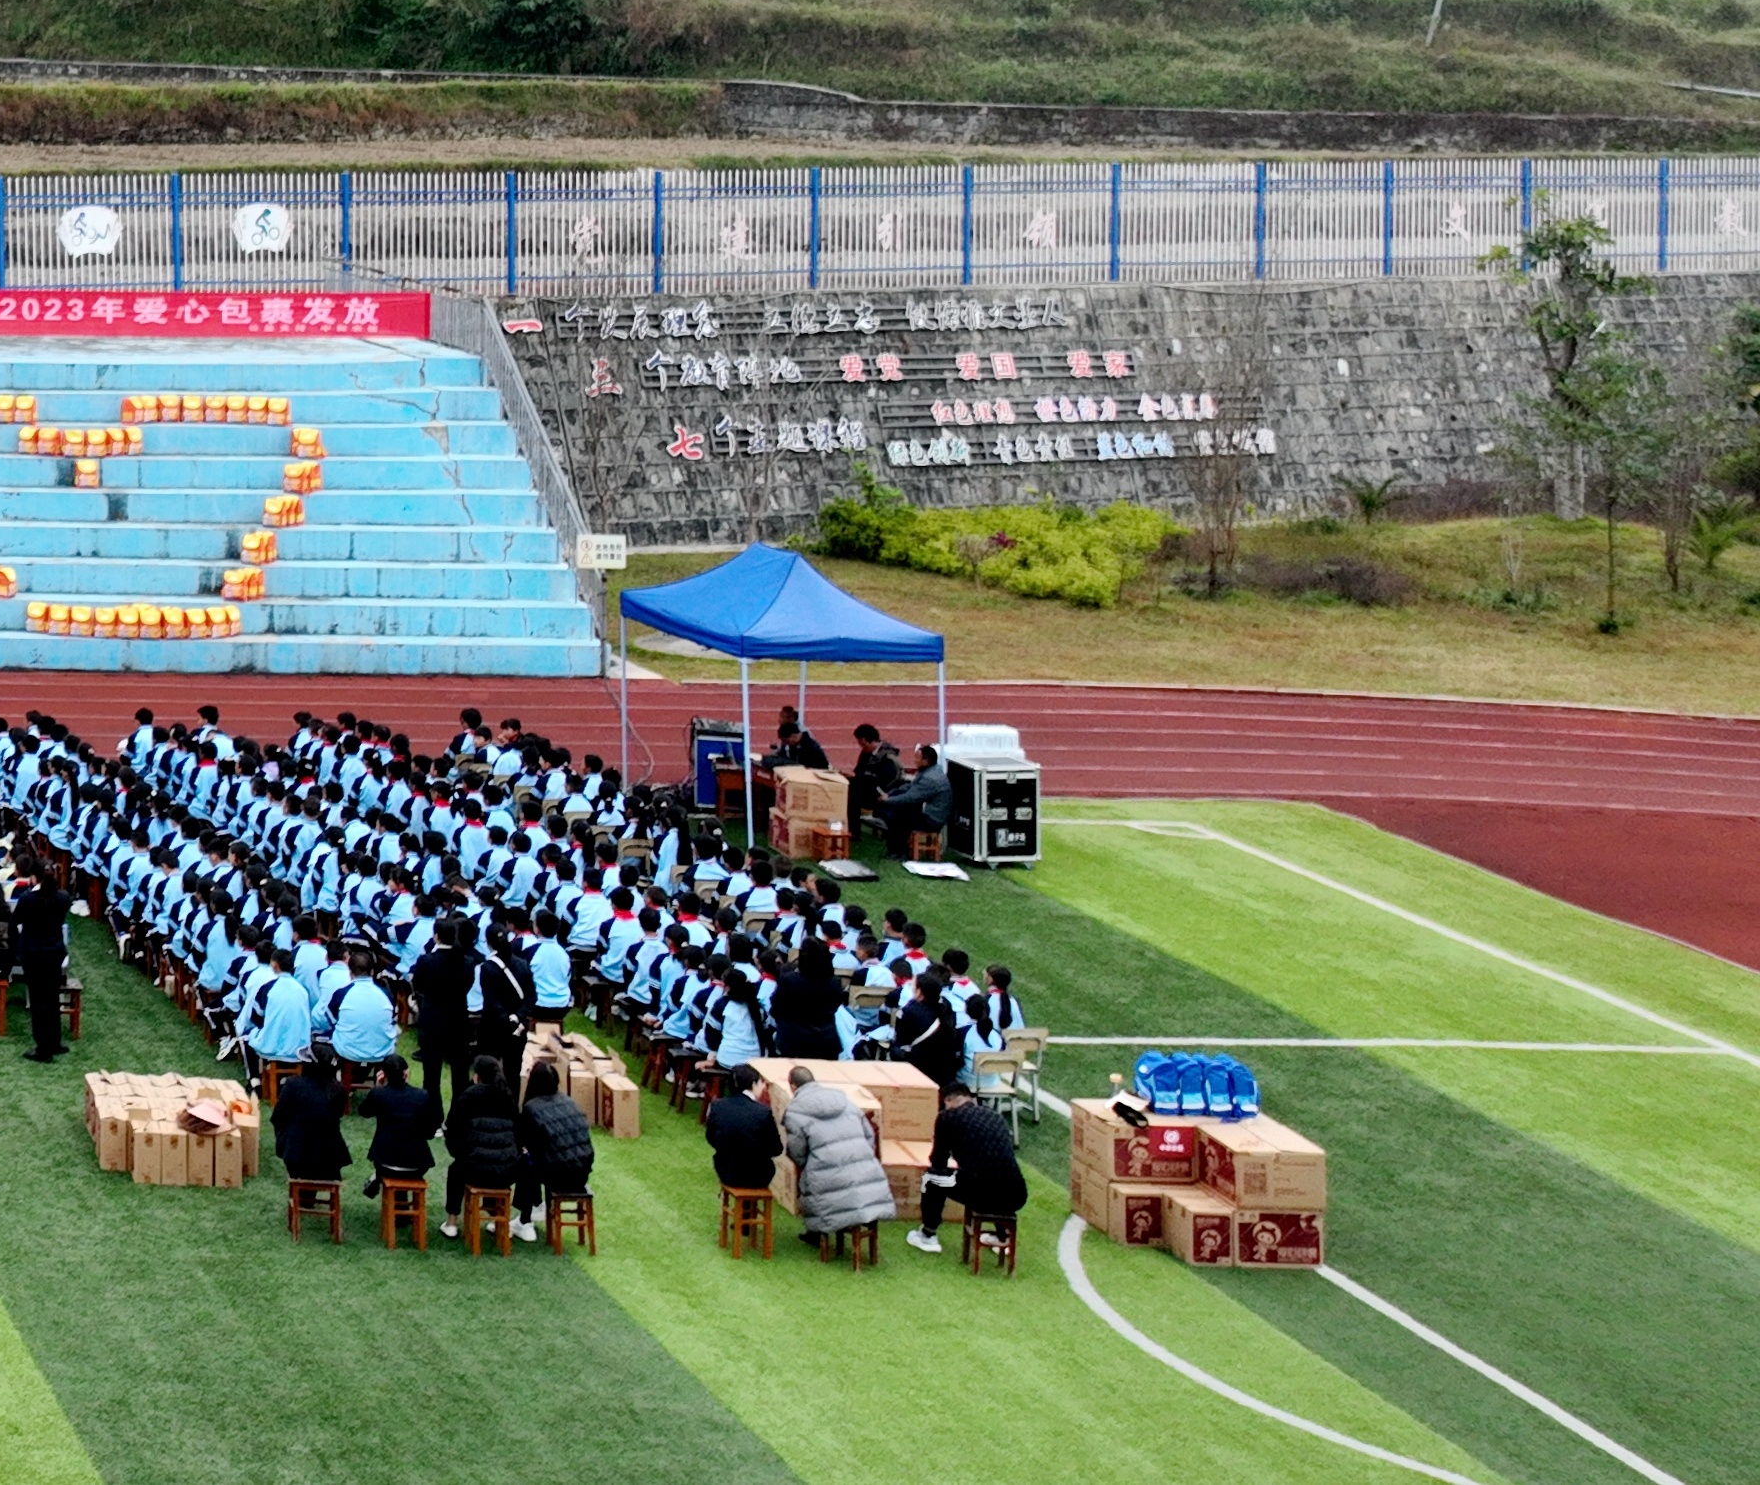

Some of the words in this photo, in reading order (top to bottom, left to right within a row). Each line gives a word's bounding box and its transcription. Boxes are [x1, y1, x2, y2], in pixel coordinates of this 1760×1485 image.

[839, 353, 904, 383] 爱党
[955, 351, 1019, 381] 爱国
[1066, 349, 1130, 379] 爱家
